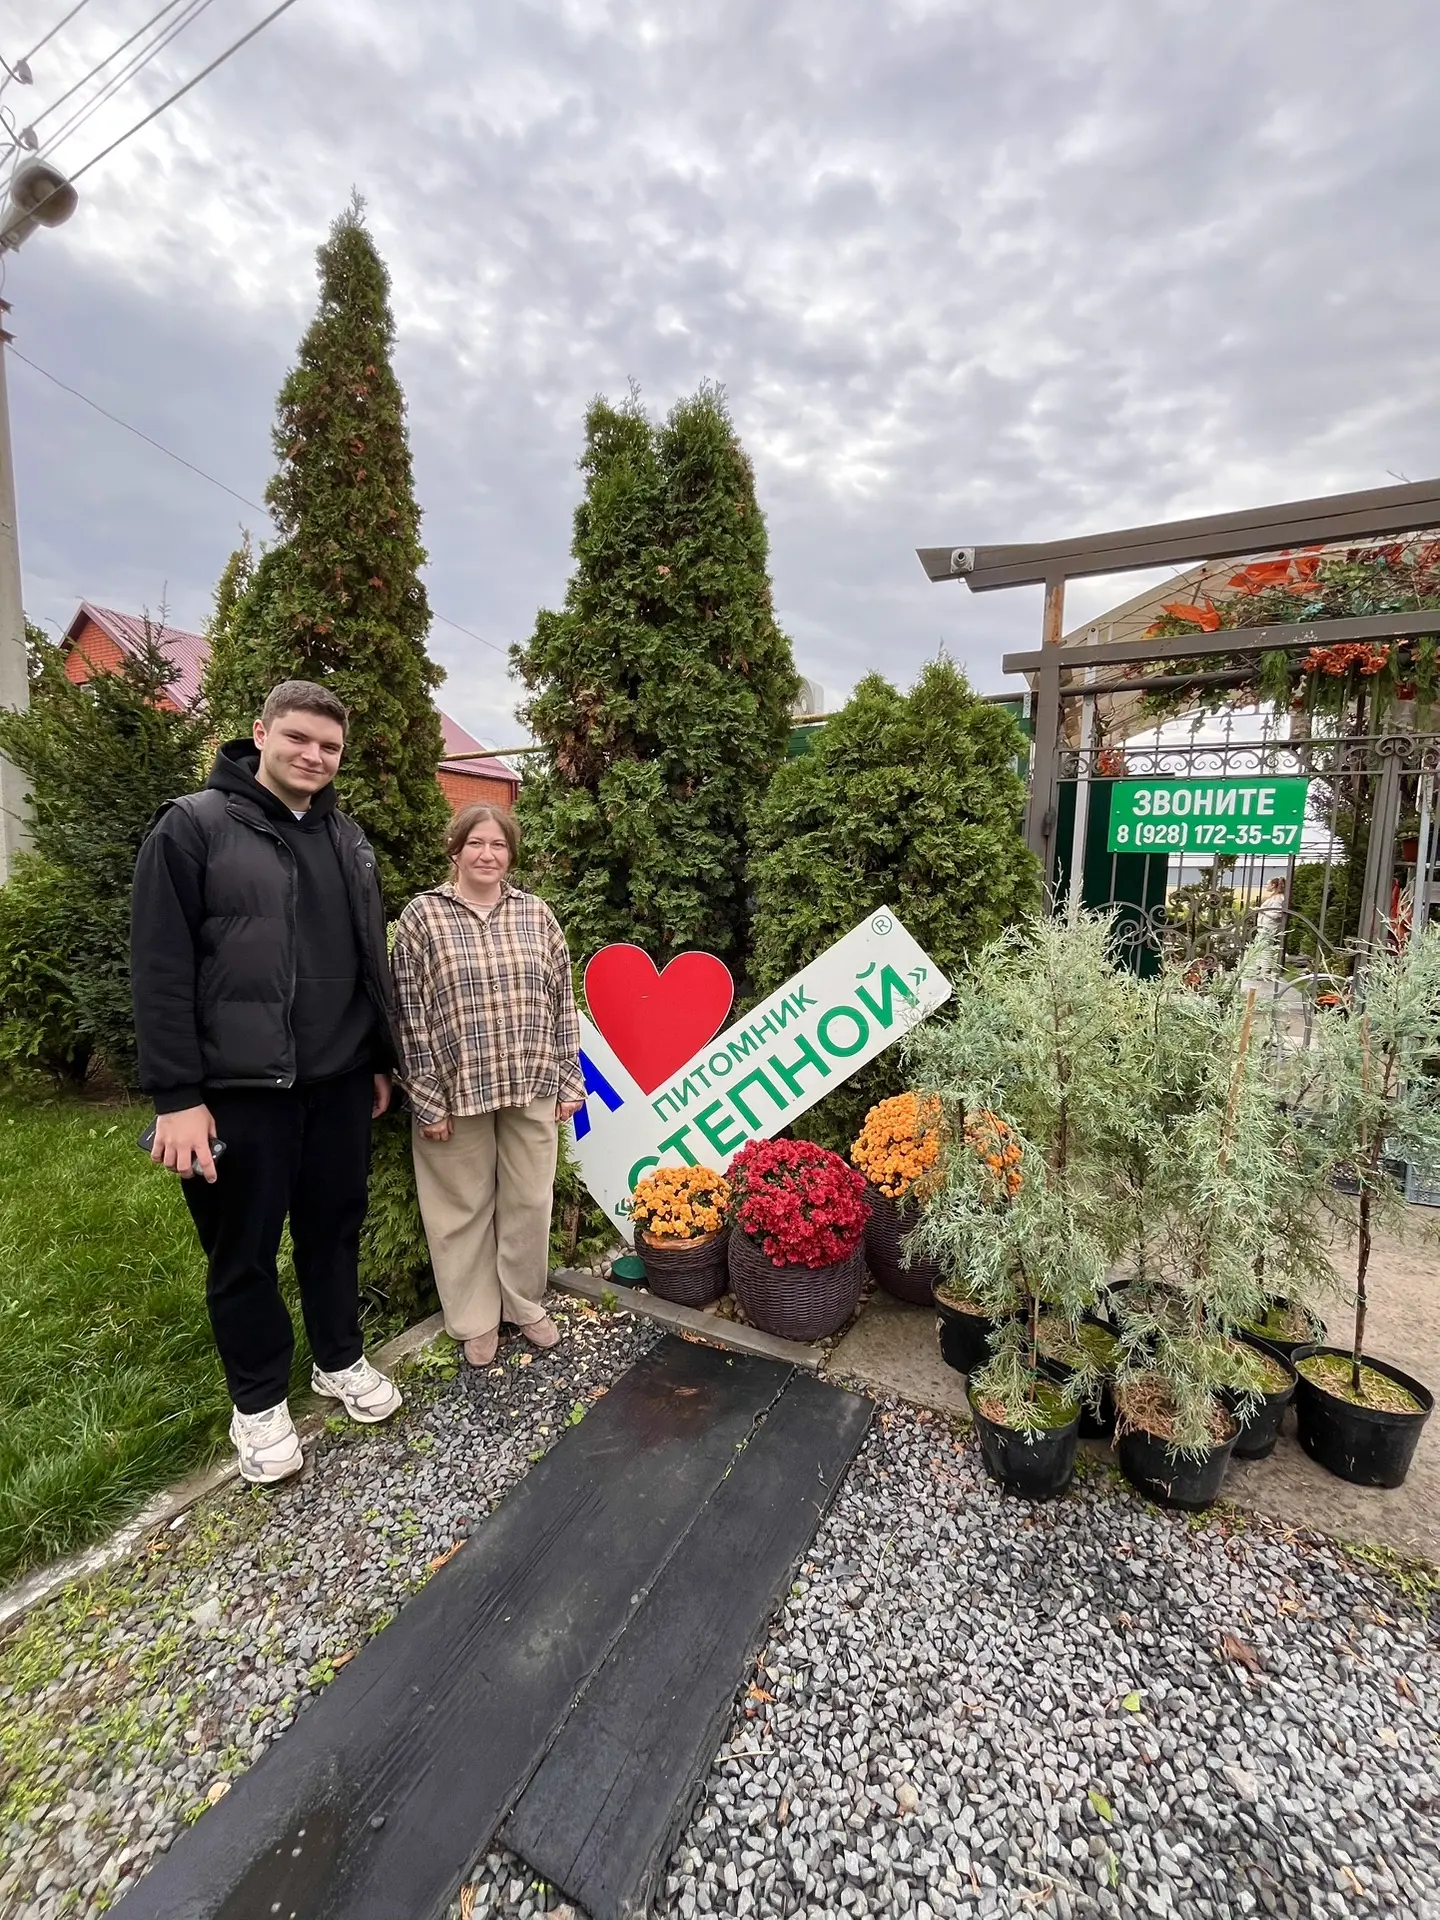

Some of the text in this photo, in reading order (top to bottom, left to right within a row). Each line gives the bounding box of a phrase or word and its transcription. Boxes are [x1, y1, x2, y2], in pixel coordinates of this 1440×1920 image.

[1132, 788, 1276, 816] ЗВОНИТЕ
[1116, 822, 1298, 846] 8 (928) 172-35-57
[651, 984, 818, 1123] ПИТОМНИК
